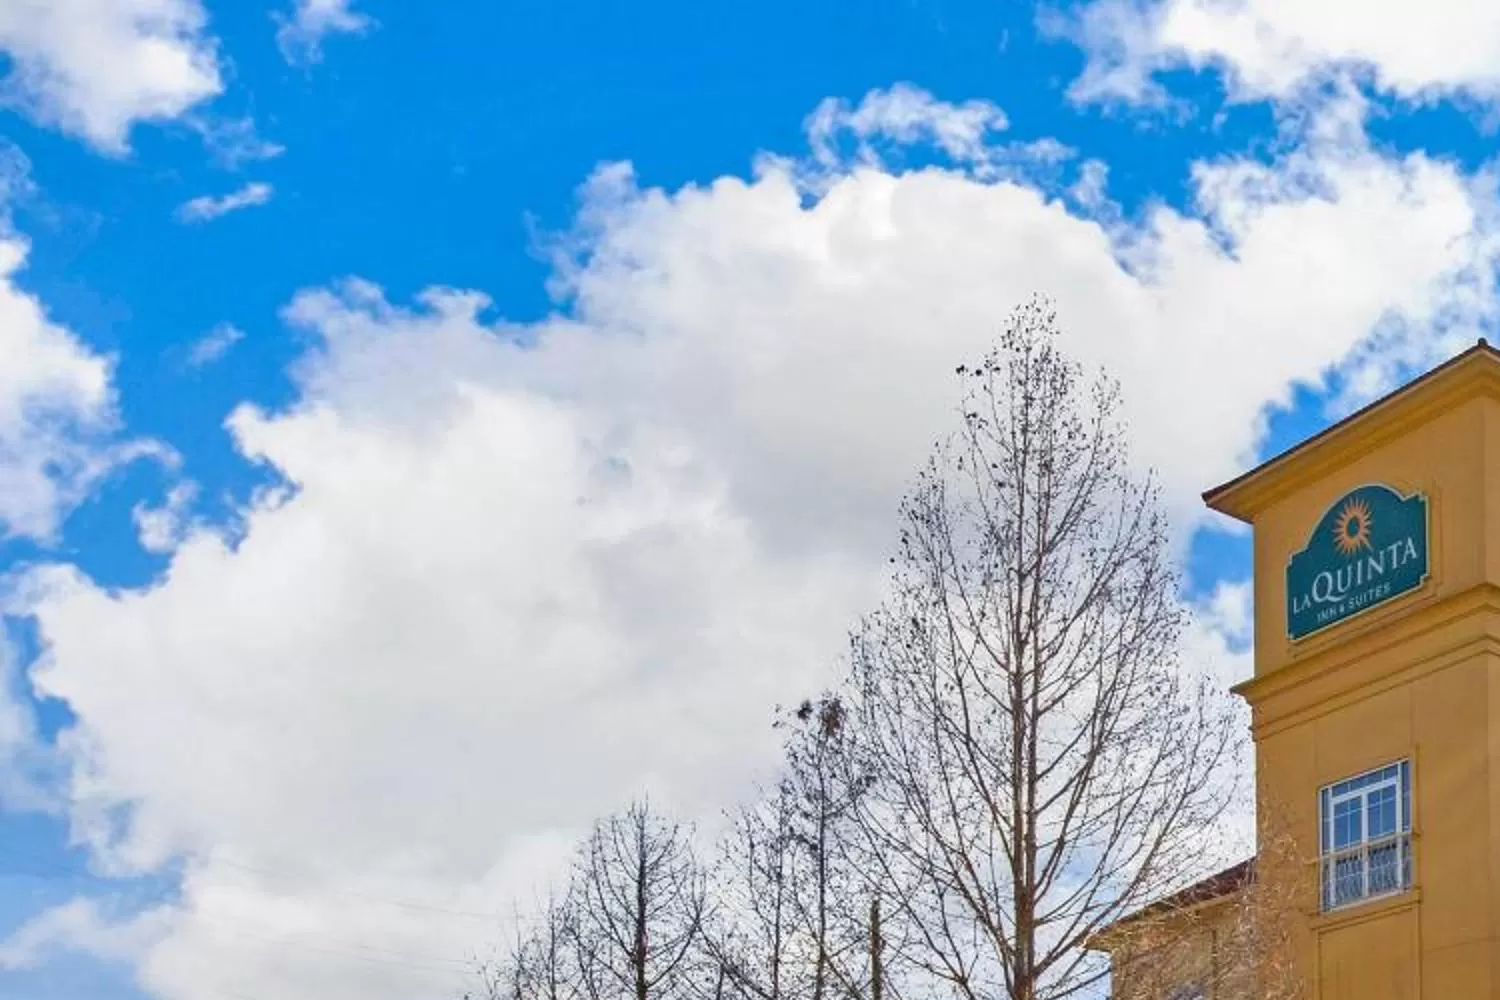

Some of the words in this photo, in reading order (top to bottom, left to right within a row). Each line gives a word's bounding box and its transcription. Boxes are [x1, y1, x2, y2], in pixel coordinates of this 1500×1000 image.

[1293, 594, 1311, 614] LA
[1312, 537, 1417, 603] QUINTA
[1347, 582, 1391, 609] SUITES
